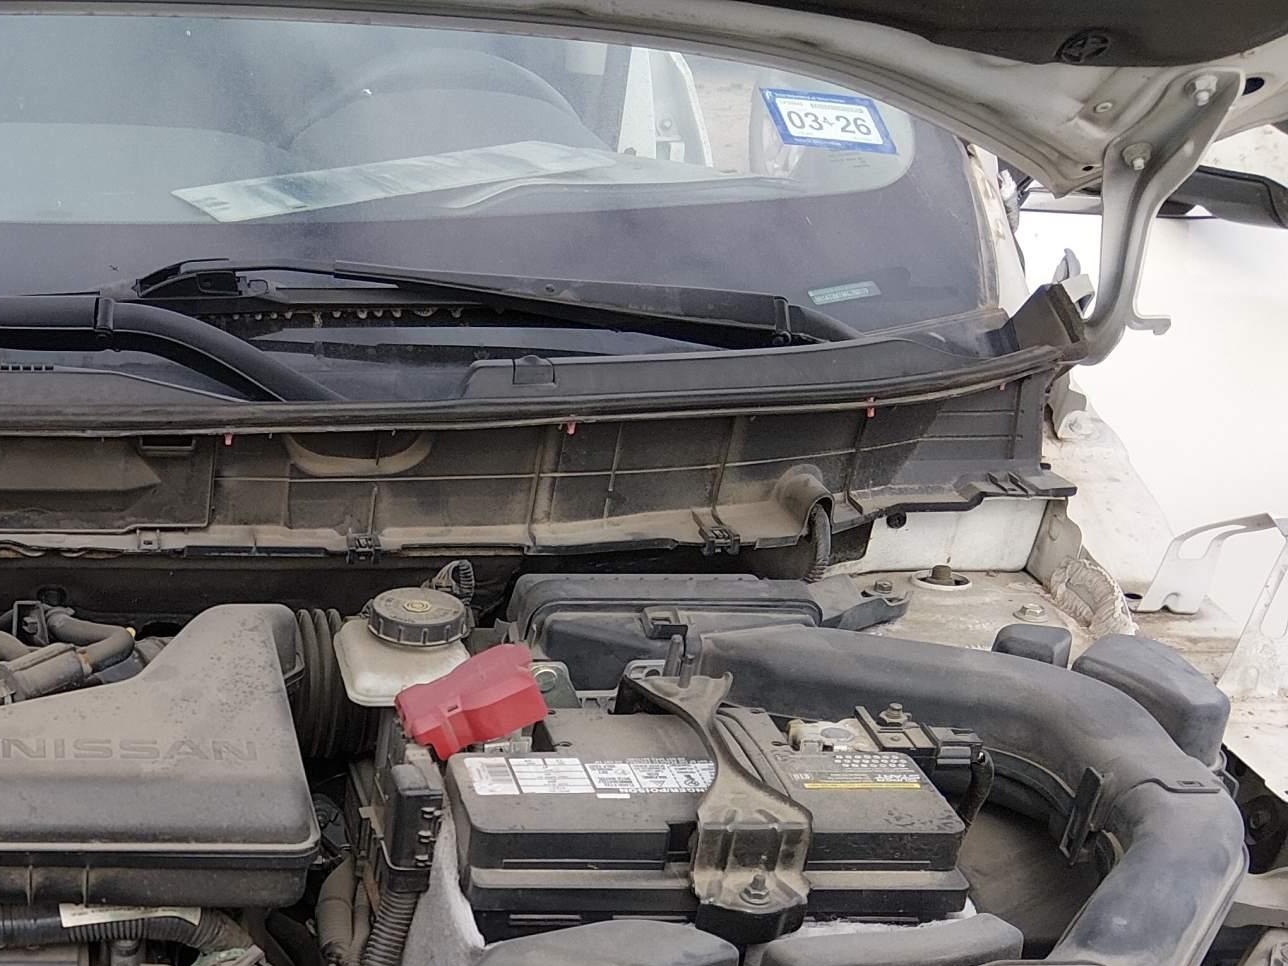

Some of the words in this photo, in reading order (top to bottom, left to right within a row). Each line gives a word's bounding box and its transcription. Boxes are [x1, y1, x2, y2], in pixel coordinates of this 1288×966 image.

[787, 110, 824, 131] 03
[835, 115, 872, 136] 26
[1, 738, 258, 761] NISSAN
